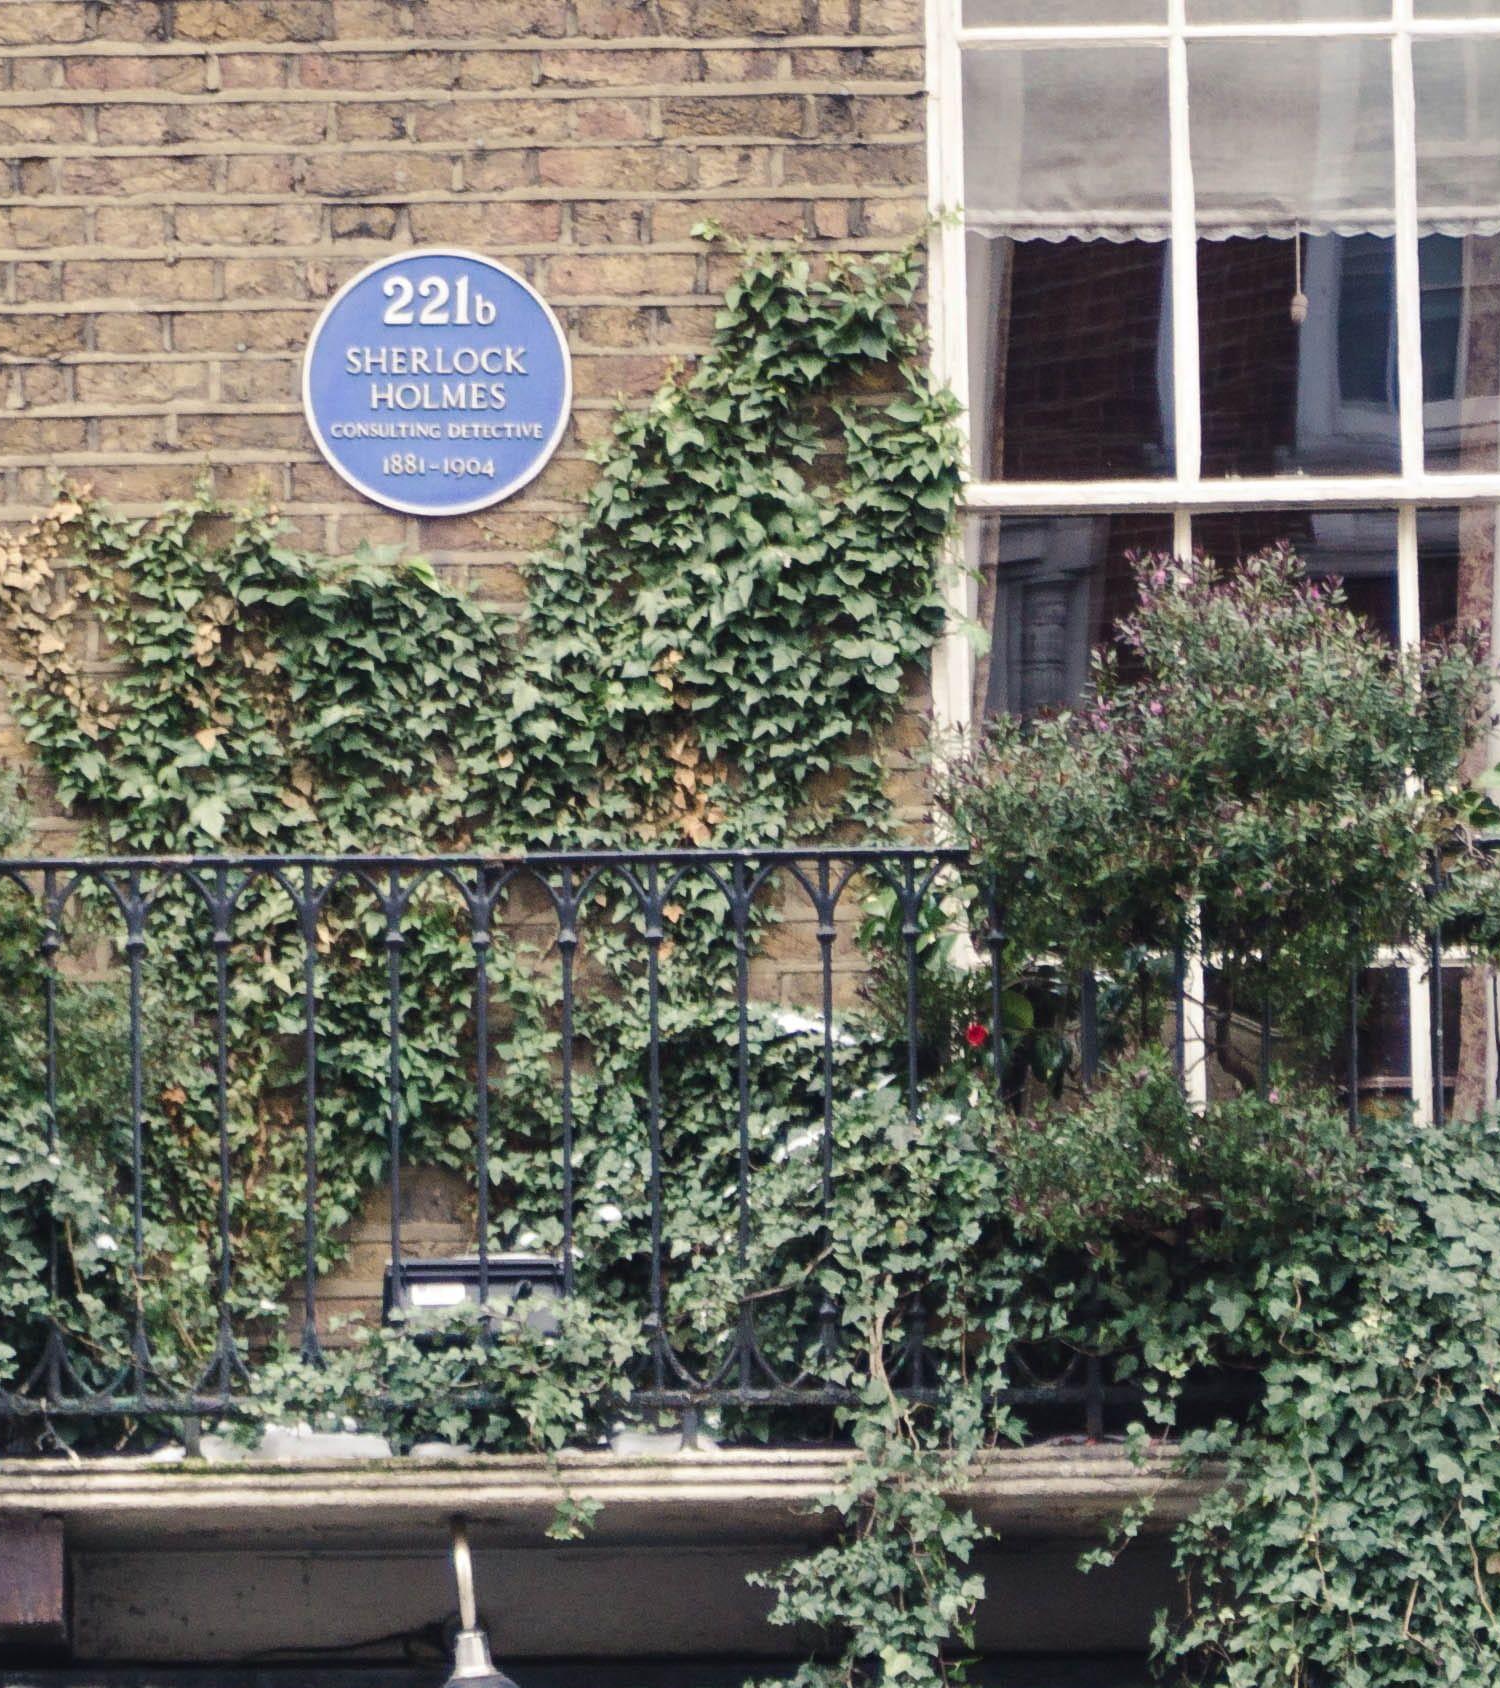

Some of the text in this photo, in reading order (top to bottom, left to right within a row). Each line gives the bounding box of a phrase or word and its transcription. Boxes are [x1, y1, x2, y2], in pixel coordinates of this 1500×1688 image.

[382, 275, 496, 326] 221b
[345, 347, 528, 375] SHERLOCK
[370, 383, 507, 410] HOLMES
[331, 423, 544, 439] CONSULTING DETECTIVE
[382, 455, 495, 478] 1881-1904
